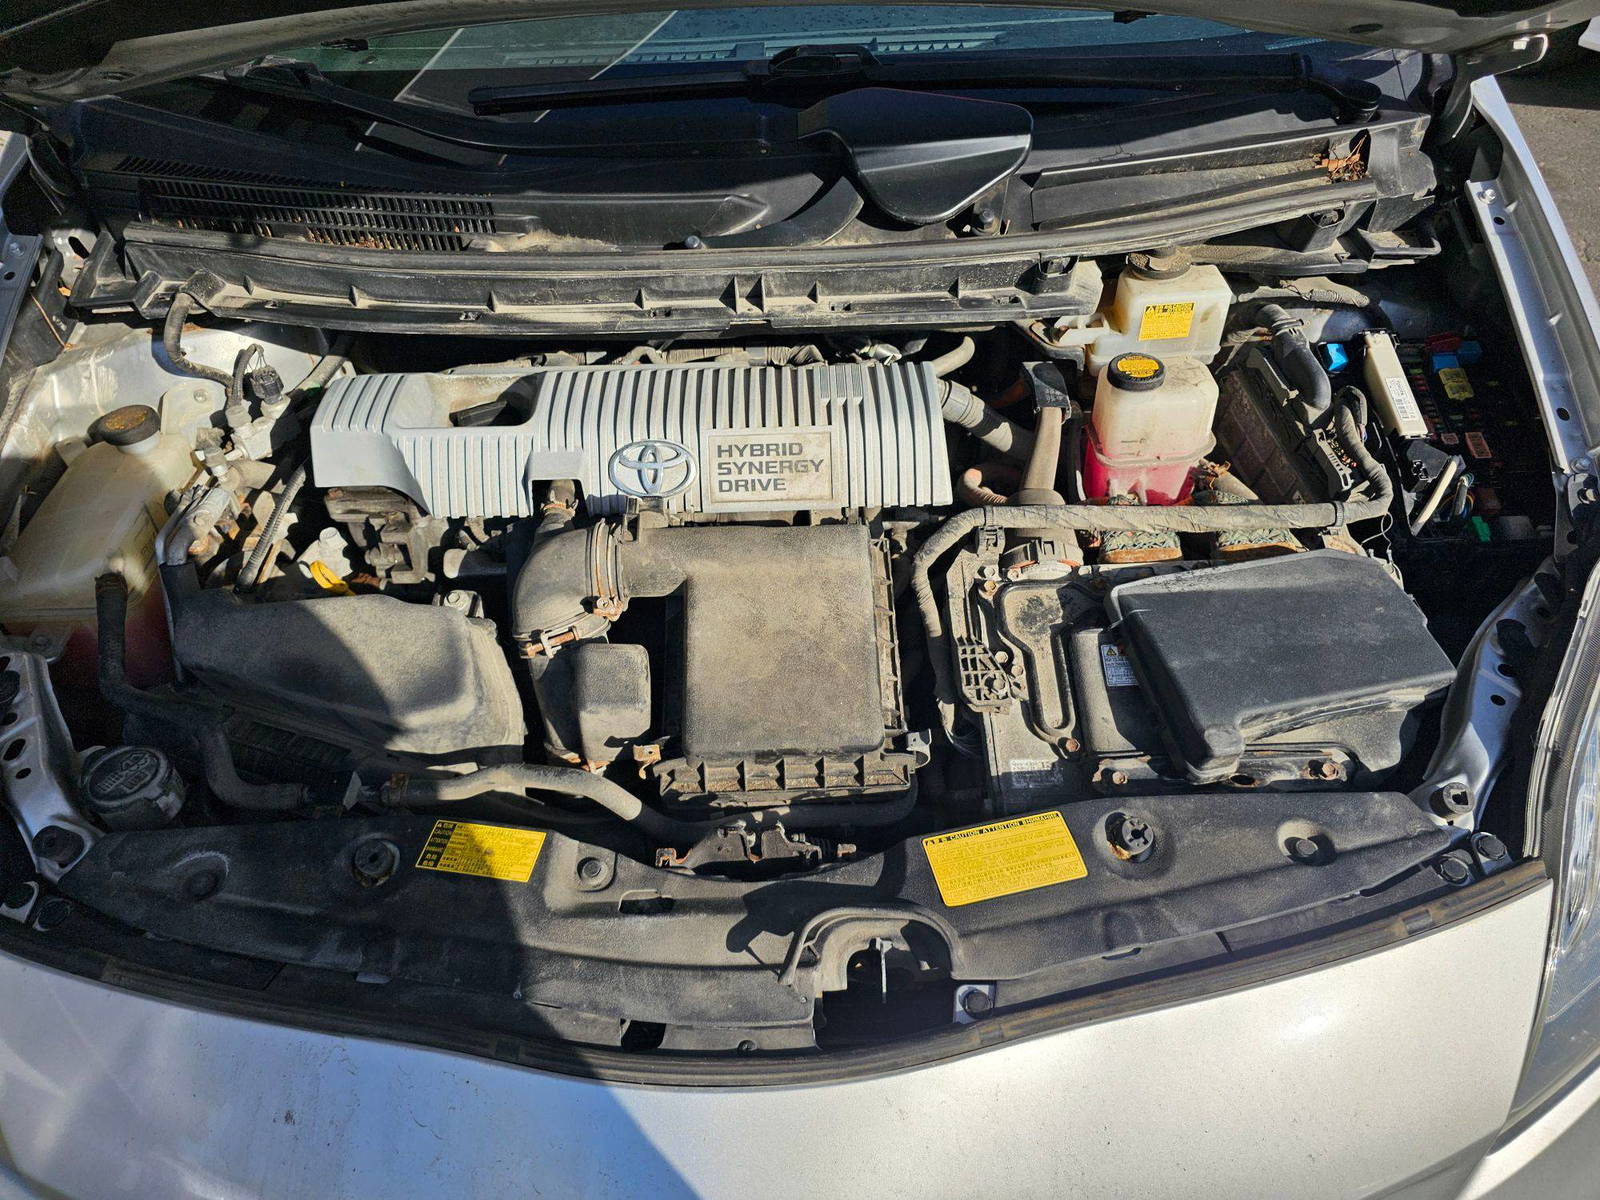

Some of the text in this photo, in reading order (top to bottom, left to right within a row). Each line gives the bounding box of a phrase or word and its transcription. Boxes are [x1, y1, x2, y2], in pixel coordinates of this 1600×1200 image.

[717, 442, 803, 457] HYBRID
[717, 459, 824, 475] SYNERGY
[719, 478, 787, 492] DRIVE
[950, 830, 980, 841] CAUTION
[983, 821, 1020, 833] ATTENTION
